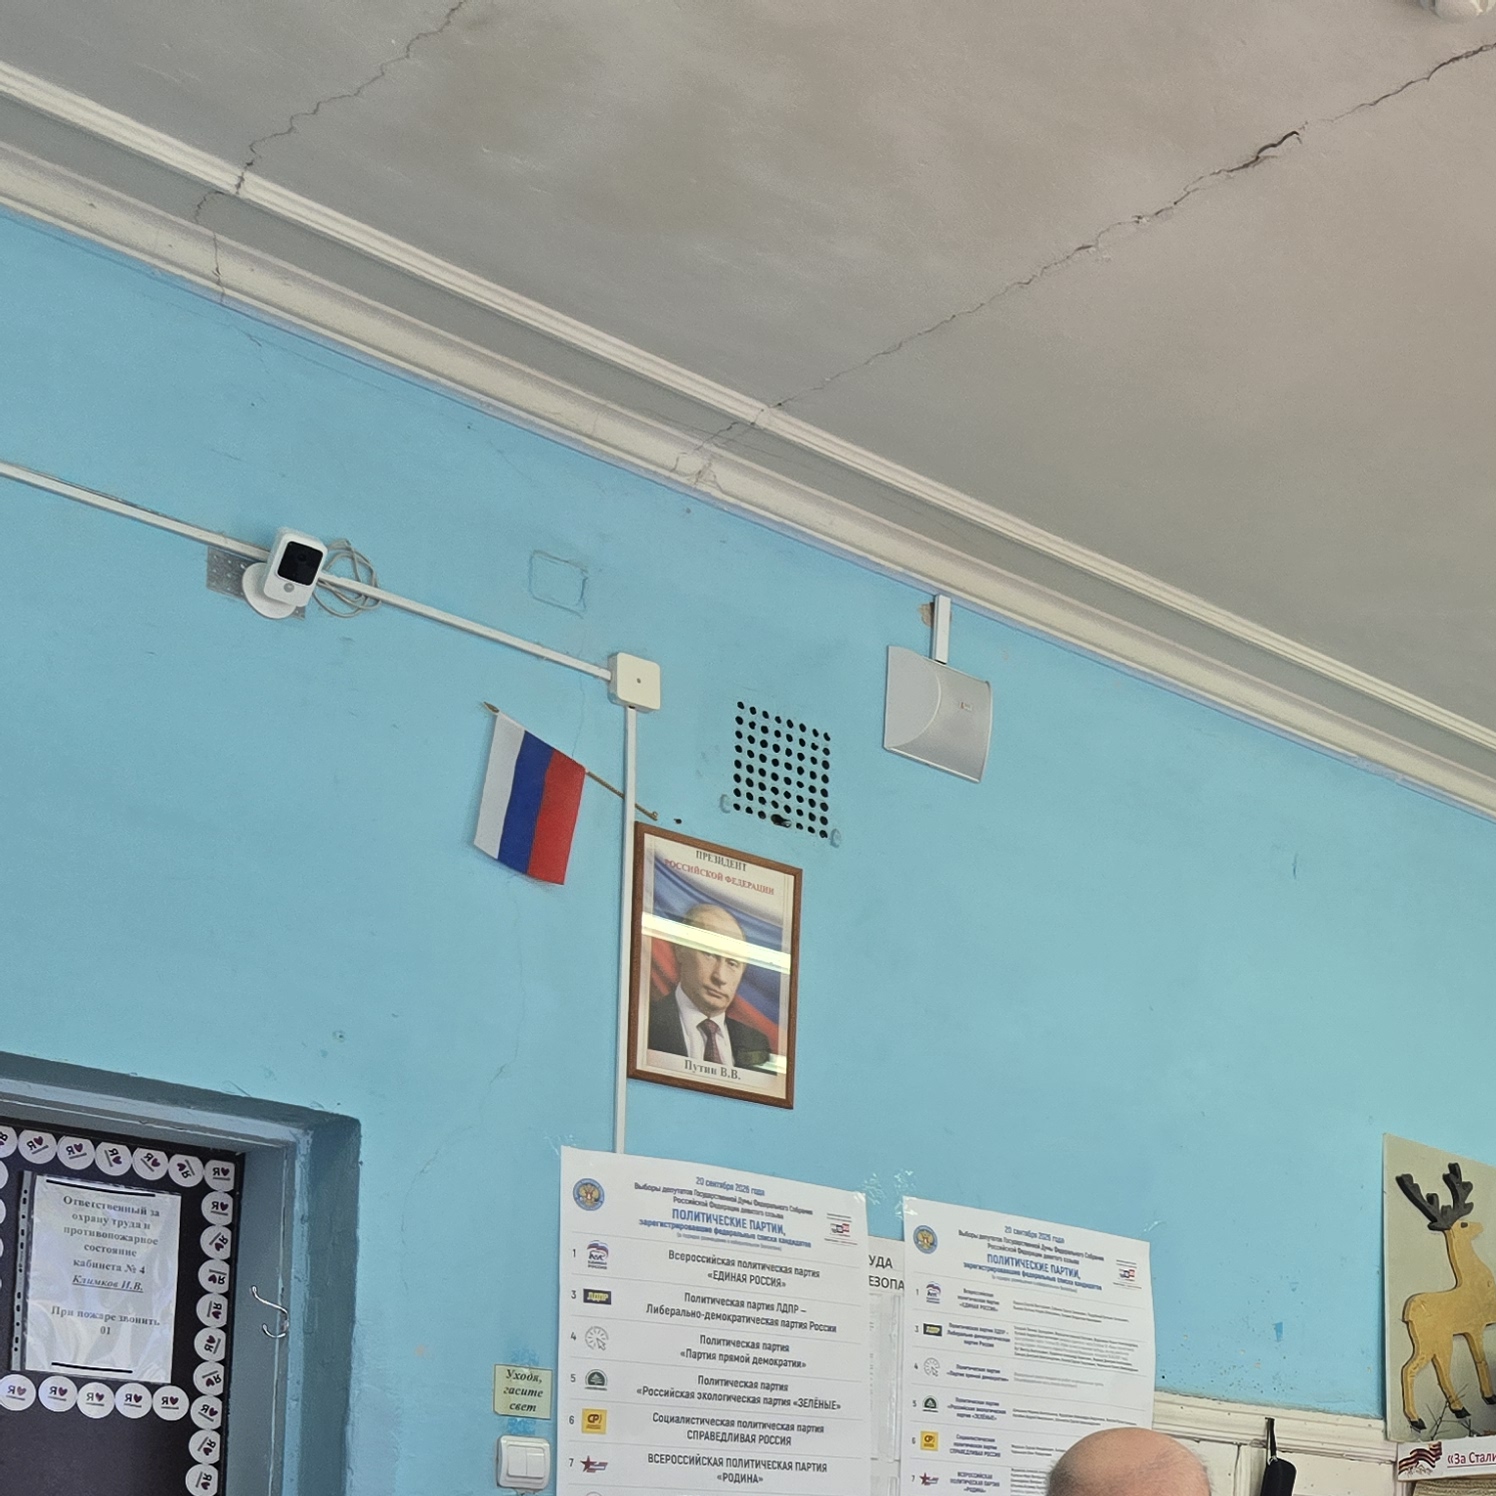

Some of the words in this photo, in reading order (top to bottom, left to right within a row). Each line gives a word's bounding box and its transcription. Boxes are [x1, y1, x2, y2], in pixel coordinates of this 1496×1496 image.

[696, 850, 746, 872] ПРЕЗИДЕНТ
[665, 859, 723, 881] РОССИЙСКОЙ
[725, 875, 775, 895] ФЕДЕРАЦИИ
[685, 1060, 717, 1078] Путин
[721, 1067, 741, 1080] В.В.
[27, 1141, 36, 1150] Я
[212, 1168, 220, 1176] Я
[696, 1177, 704, 1186] 20
[64, 1196, 147, 1216] Ответственный
[212, 1201, 220, 1210] Я
[72, 1213, 109, 1226] охрану
[112, 1219, 141, 1229] труда
[672, 1208, 747, 1229] ПОЛИТИЧЕСКИЕ
[749, 1220, 786, 1236] ПАРТИИ,
[64, 1226, 158, 1245] противопожарное
[84, 1244, 137, 1257] состояние
[573, 1249, 576, 1257] 1
[73, 1260, 122, 1272] кабинета
[139, 1266, 145, 1274] 4
[669, 1250, 735, 1267] Всероссийская
[737, 1259, 792, 1274] политическая
[794, 1268, 820, 1278] партия
[869, 1254, 893, 1269] УДА
[987, 1254, 1049, 1273] ПОЛИТИЧЕСКИЕ
[1050, 1265, 1081, 1279] ПАРТИИ,
[72, 1275, 119, 1287] Климков
[121, 1281, 143, 1291] И.В.
[708, 1270, 747, 1283] «ЕДИНАЯ
[749, 1275, 786, 1288] РОССИЯ»
[571, 1290, 576, 1299] 3
[587, 1291, 608, 1302] ЛДПР
[684, 1293, 745, 1310] Политическая
[747, 1300, 774, 1312] партия
[776, 1302, 799, 1314] ЛДПР
[52, 1306, 74, 1317] При
[78, 1310, 116, 1322] пожаре
[119, 1315, 160, 1325] звонить
[646, 1304, 778, 1326] Либерально-демократическая
[781, 1318, 807, 1330] партия
[809, 1321, 837, 1332] России
[100, 1326, 110, 1334] 01
[570, 1332, 577, 1341] 4
[700, 1335, 760, 1351] Политическая
[762, 1343, 789, 1353] партия
[680, 1349, 716, 1362] «Партия
[719, 1352, 750, 1366] прямой
[752, 1355, 806, 1370] демократии»
[506, 1369, 542, 1383] Уходя,
[570, 1374, 576, 1383] 5
[49, 1386, 57, 1395] Я
[697, 1375, 759, 1391] Политическая
[761, 1382, 788, 1393] партия
[125, 1393, 133, 1402] Я
[503, 1387, 543, 1397] гасите
[636, 1385, 695, 1400] «Российская
[697, 1390, 761, 1406] экологическая
[763, 1397, 791, 1408] партия
[793, 1396, 841, 1410] «ЗЕЛЁНЫЕ»
[161, 1396, 170, 1405] Я
[510, 1403, 536, 1412] свет
[569, 1416, 574, 1425] 6
[652, 1412, 735, 1427] Социалистическая
[737, 1418, 794, 1432] политическая
[797, 1424, 824, 1434] партия
[687, 1430, 756, 1444] СПРАВЕДЛИВАЯ
[759, 1434, 791, 1446] РОССИЯ
[569, 1458, 573, 1467] 7
[648, 1453, 723, 1467] ВСЕРОССИЙСКАЯ
[726, 1458, 793, 1471] ПОЛИТИЧЕСКАЯ
[795, 1462, 827, 1473] ПАРТИЯ
[1447, 1453, 1466, 1464] «За
[717, 1473, 763, 1484] «РОДИНА»
